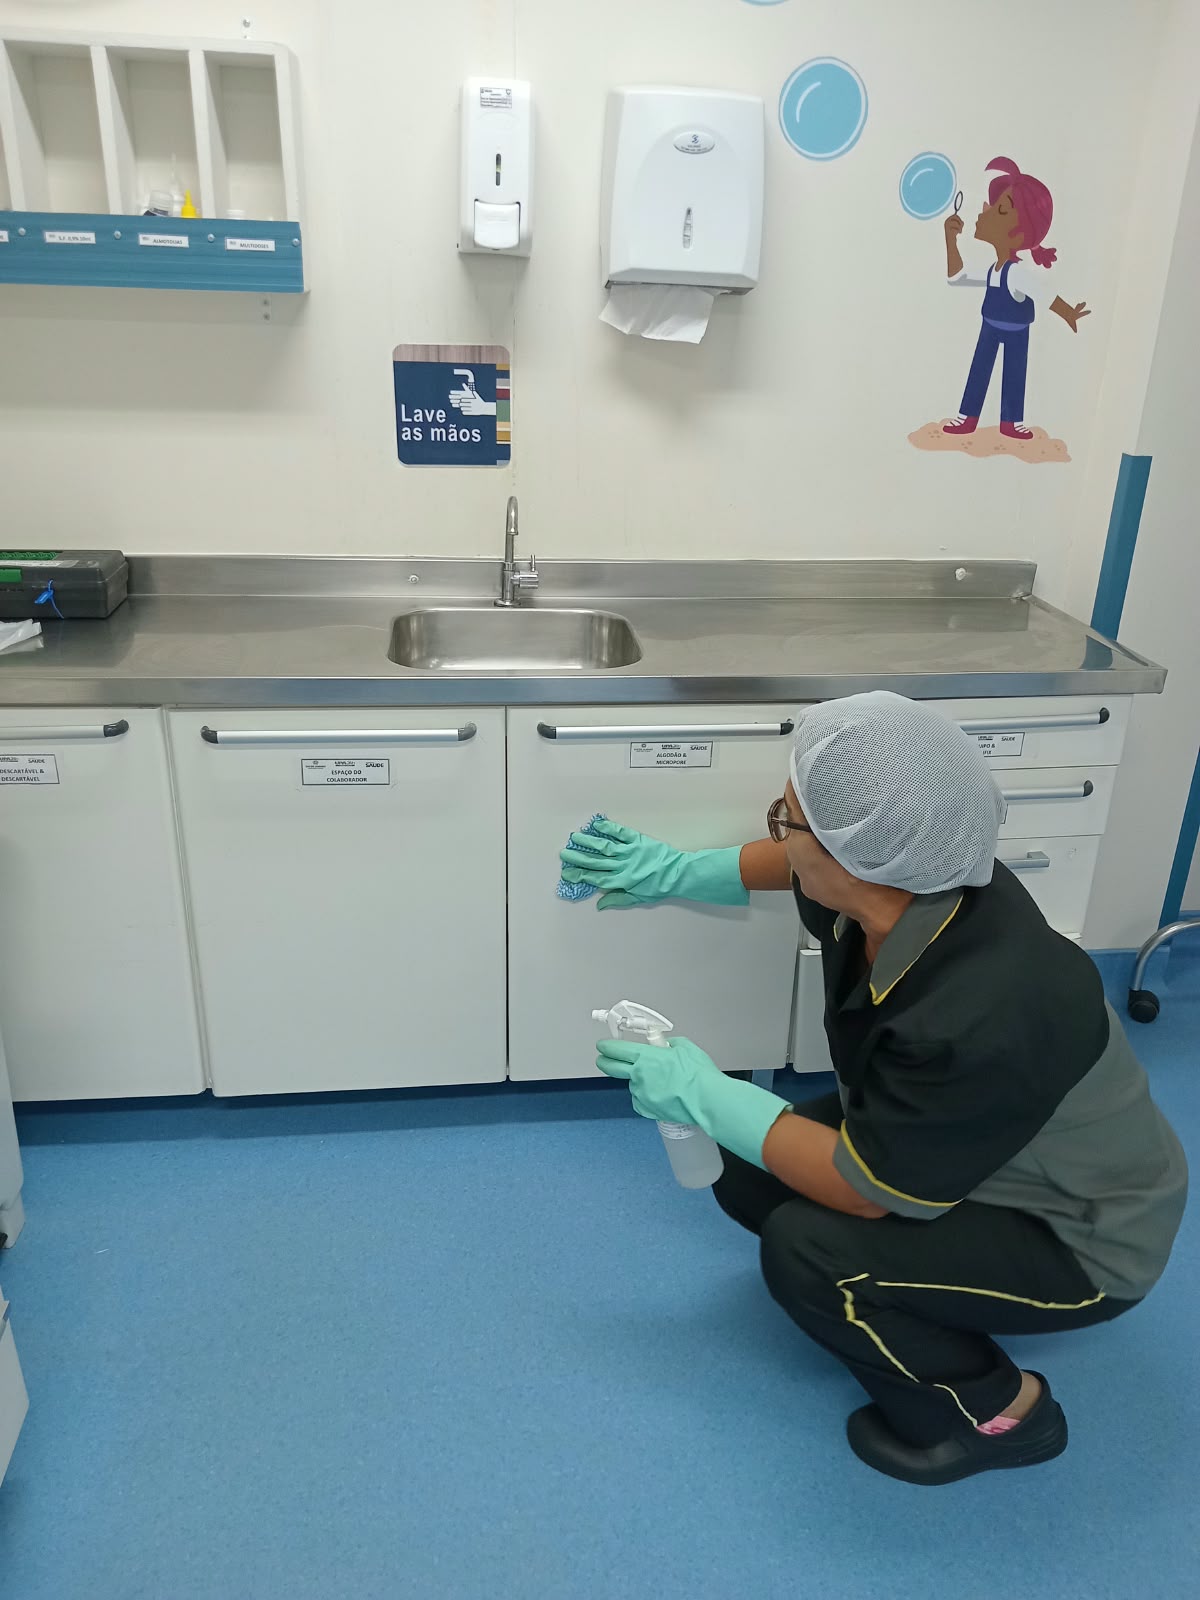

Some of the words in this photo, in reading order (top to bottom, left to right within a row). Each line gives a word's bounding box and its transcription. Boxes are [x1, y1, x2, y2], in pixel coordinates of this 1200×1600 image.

[401, 404, 446, 423] Lave
[402, 427, 423, 441] as
[430, 424, 481, 442] mãos
